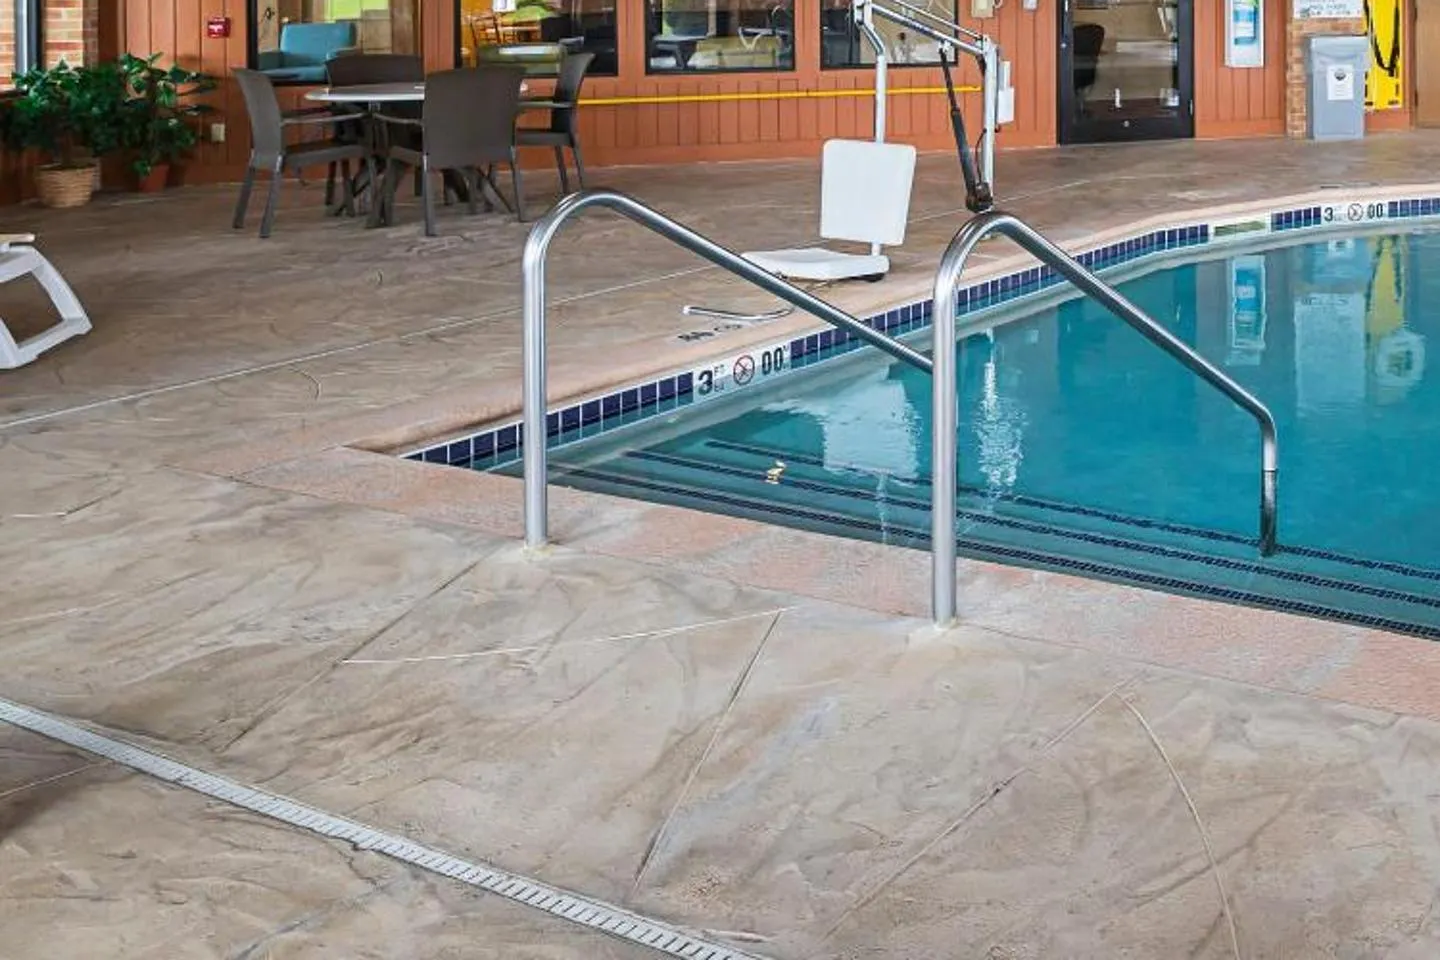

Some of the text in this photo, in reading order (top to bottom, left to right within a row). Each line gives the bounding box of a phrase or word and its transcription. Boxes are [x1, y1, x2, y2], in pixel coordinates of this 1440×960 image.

[1324, 203, 1384, 221] 3 00
[698, 370, 713, 395] 3
[761, 347, 785, 375] 00
